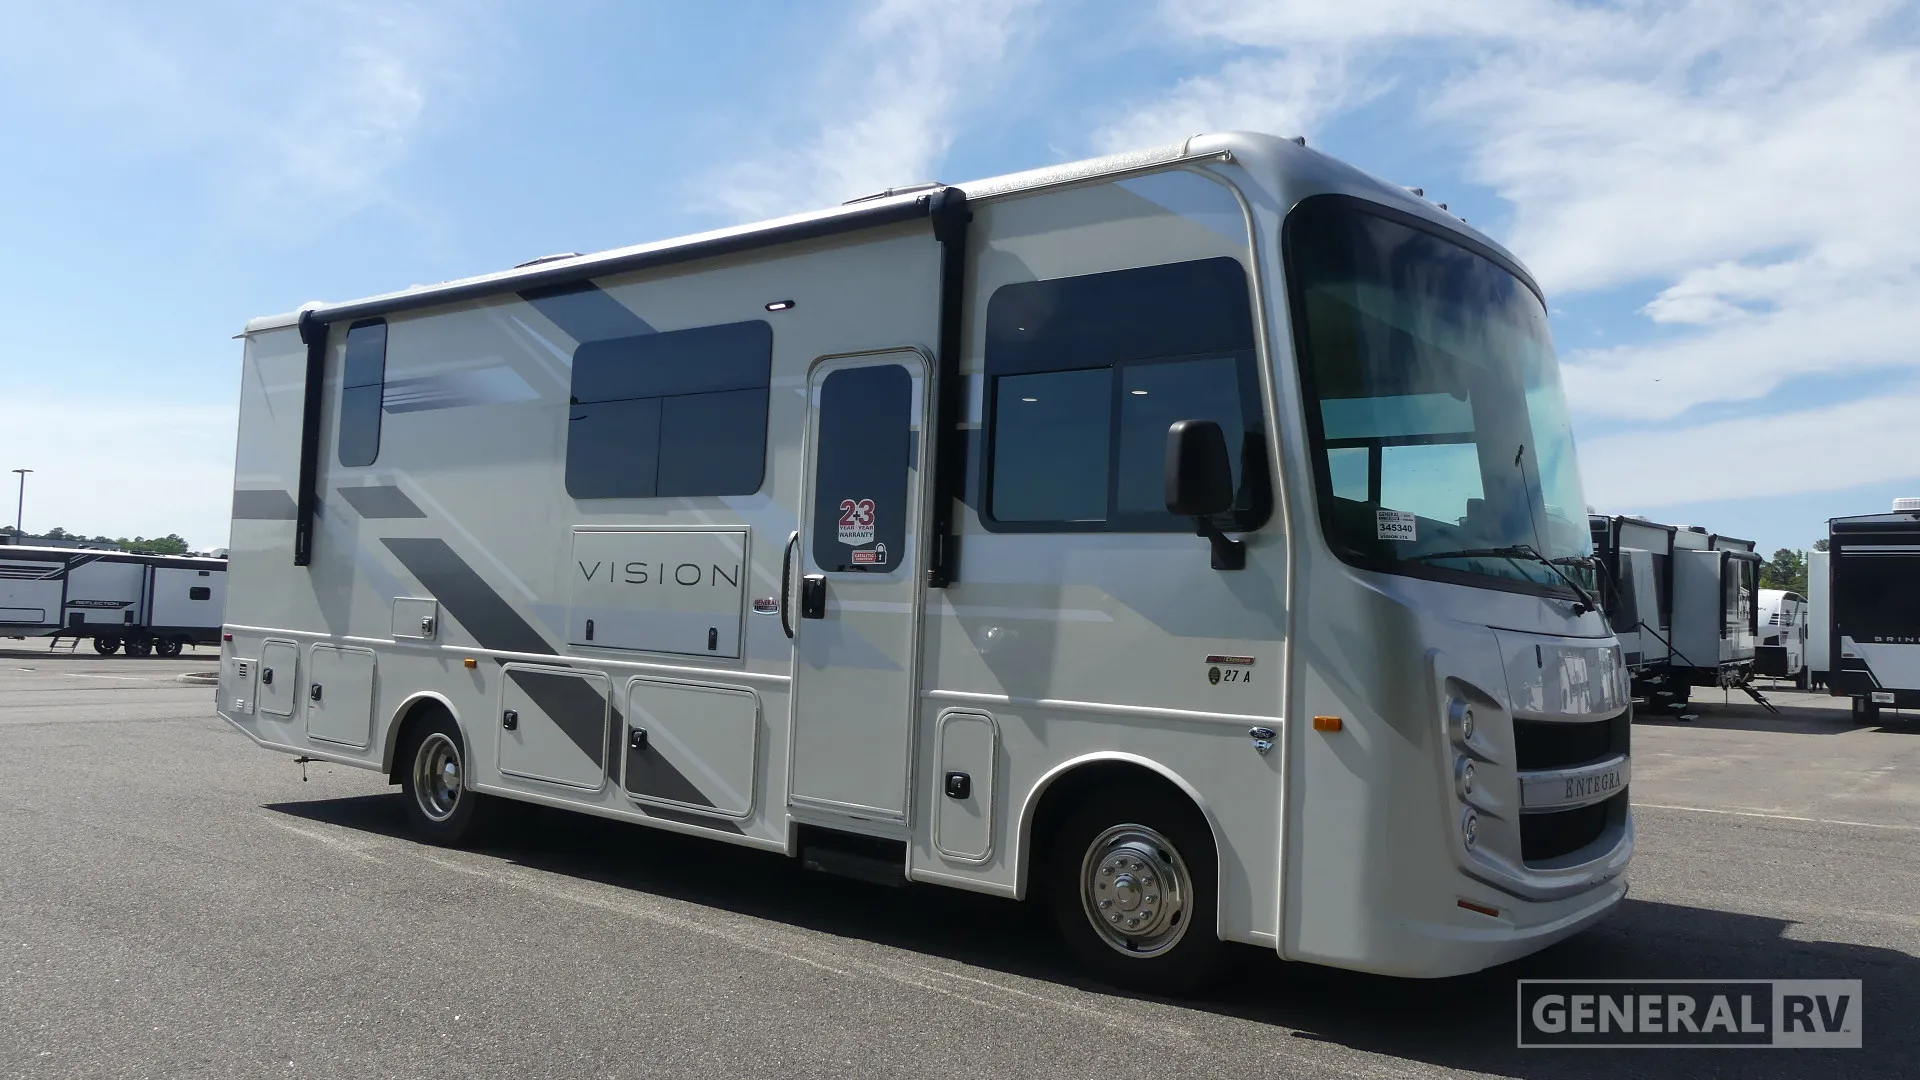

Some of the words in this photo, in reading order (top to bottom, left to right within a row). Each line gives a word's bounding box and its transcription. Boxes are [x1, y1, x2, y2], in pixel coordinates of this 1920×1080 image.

[1379, 523, 1413, 532] 345340
[578, 561, 739, 588] VISION
[1223, 669, 1239, 682] 27
[1242, 671, 1250, 682] A
